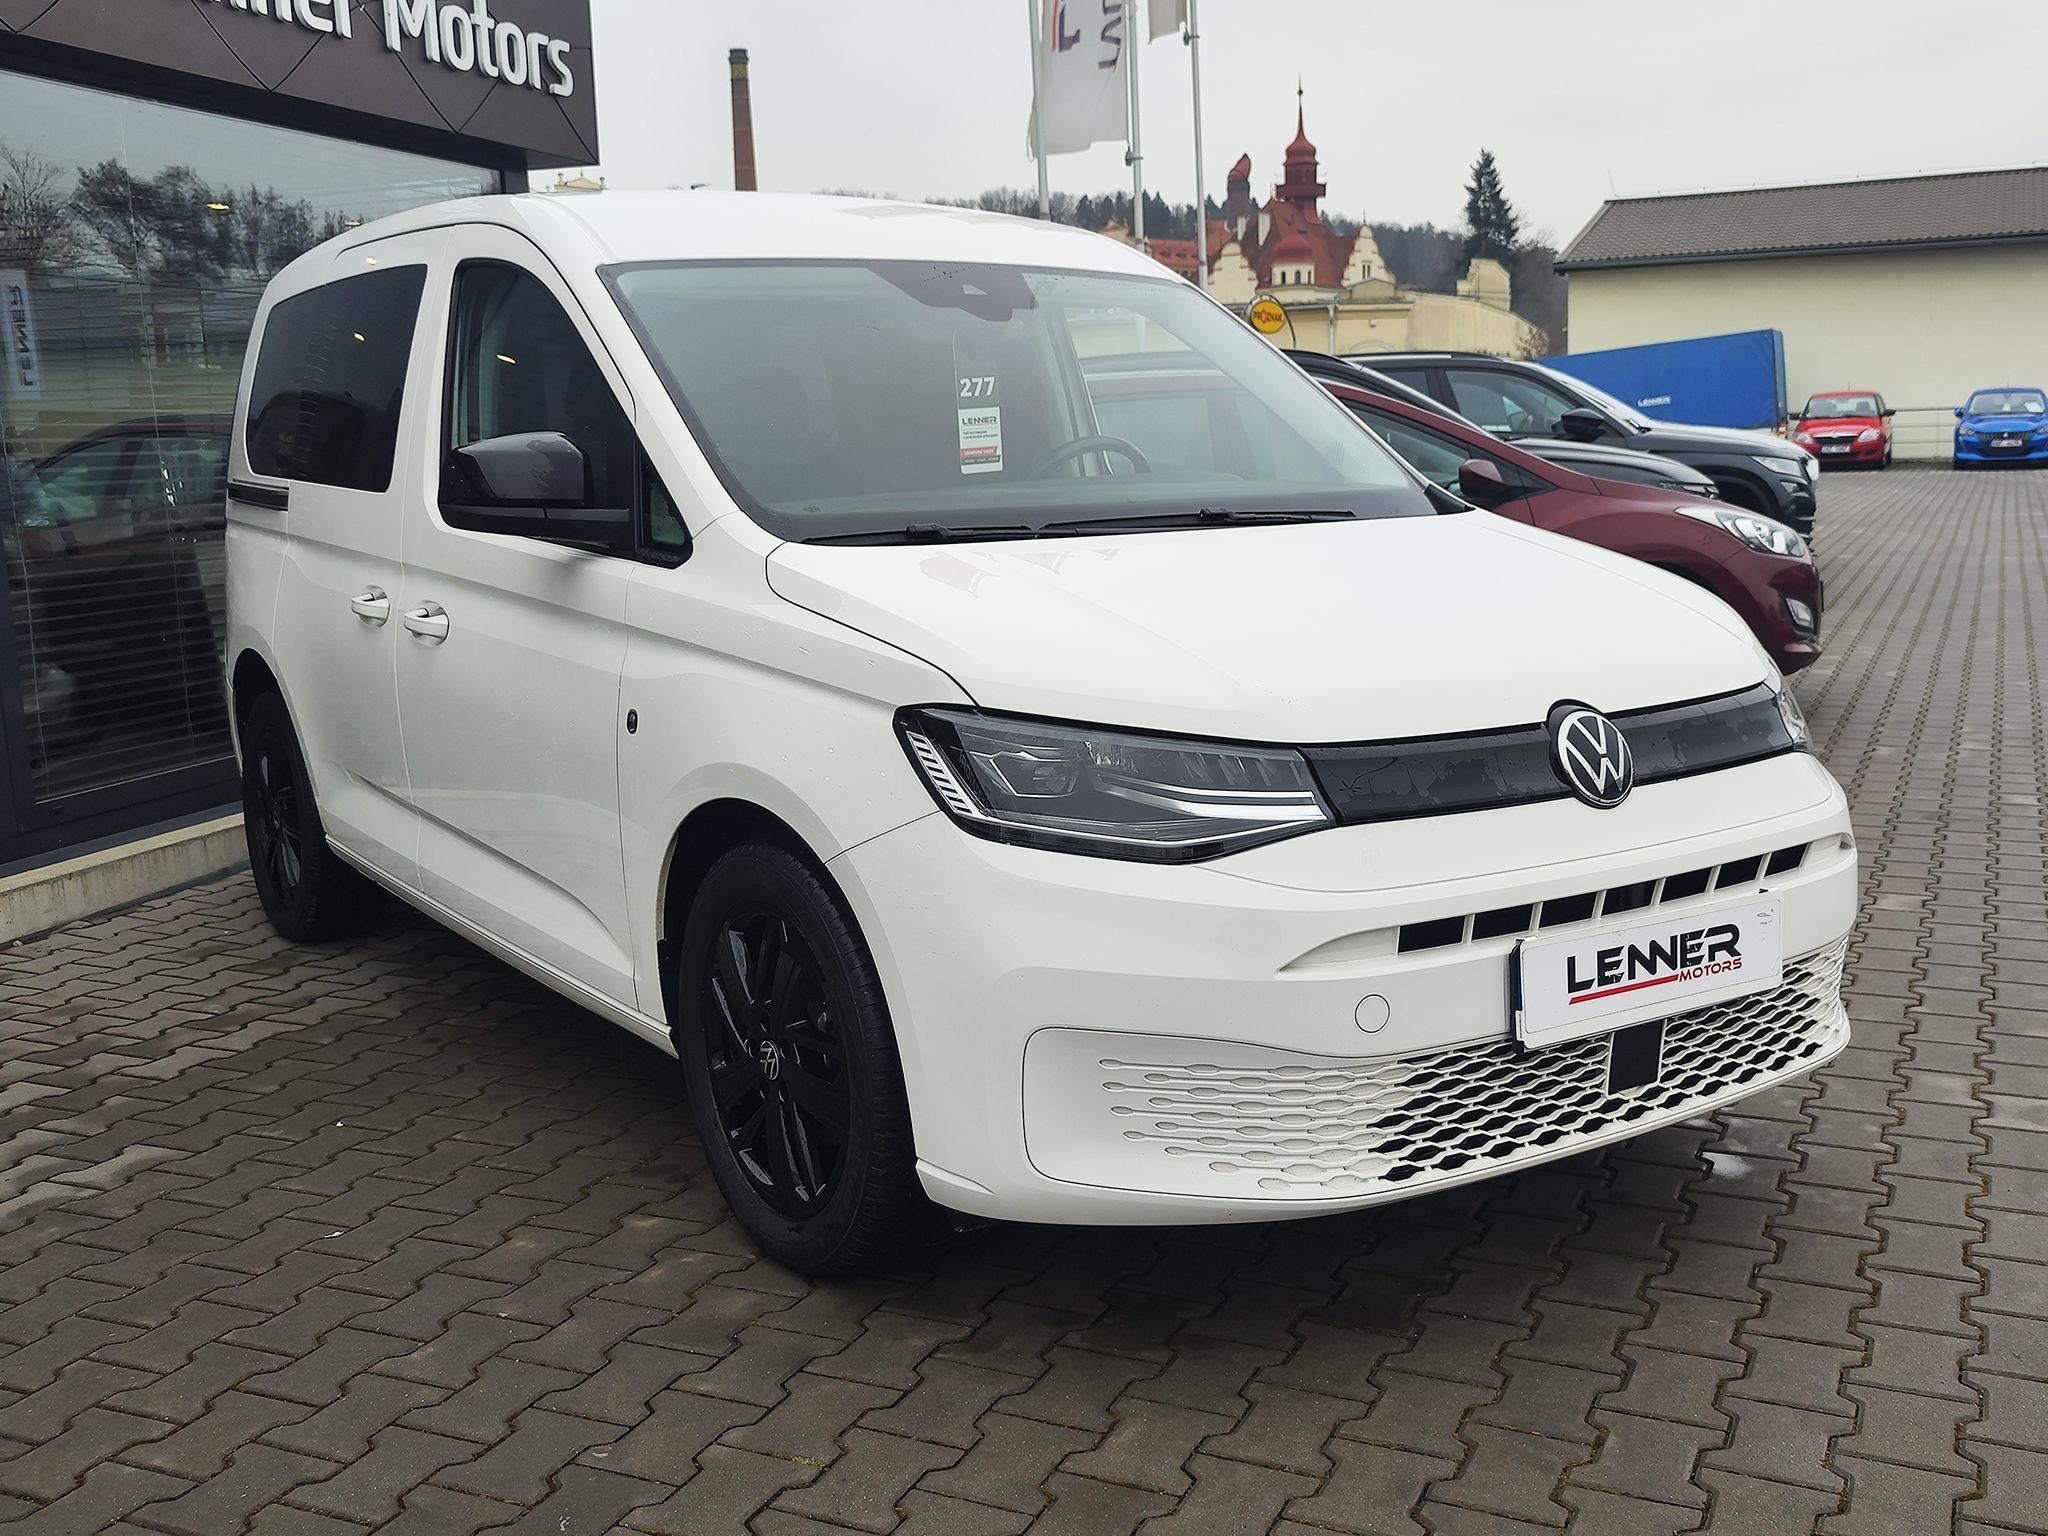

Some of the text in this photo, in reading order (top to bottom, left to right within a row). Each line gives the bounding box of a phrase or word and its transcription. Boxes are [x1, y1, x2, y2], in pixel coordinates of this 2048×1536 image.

[384, 0, 575, 97] Motors
[959, 376, 995, 397] 277
[961, 416, 998, 425] LENNER
[1567, 923, 1742, 994] LENNER
[1678, 957, 1742, 982] MOTORS
